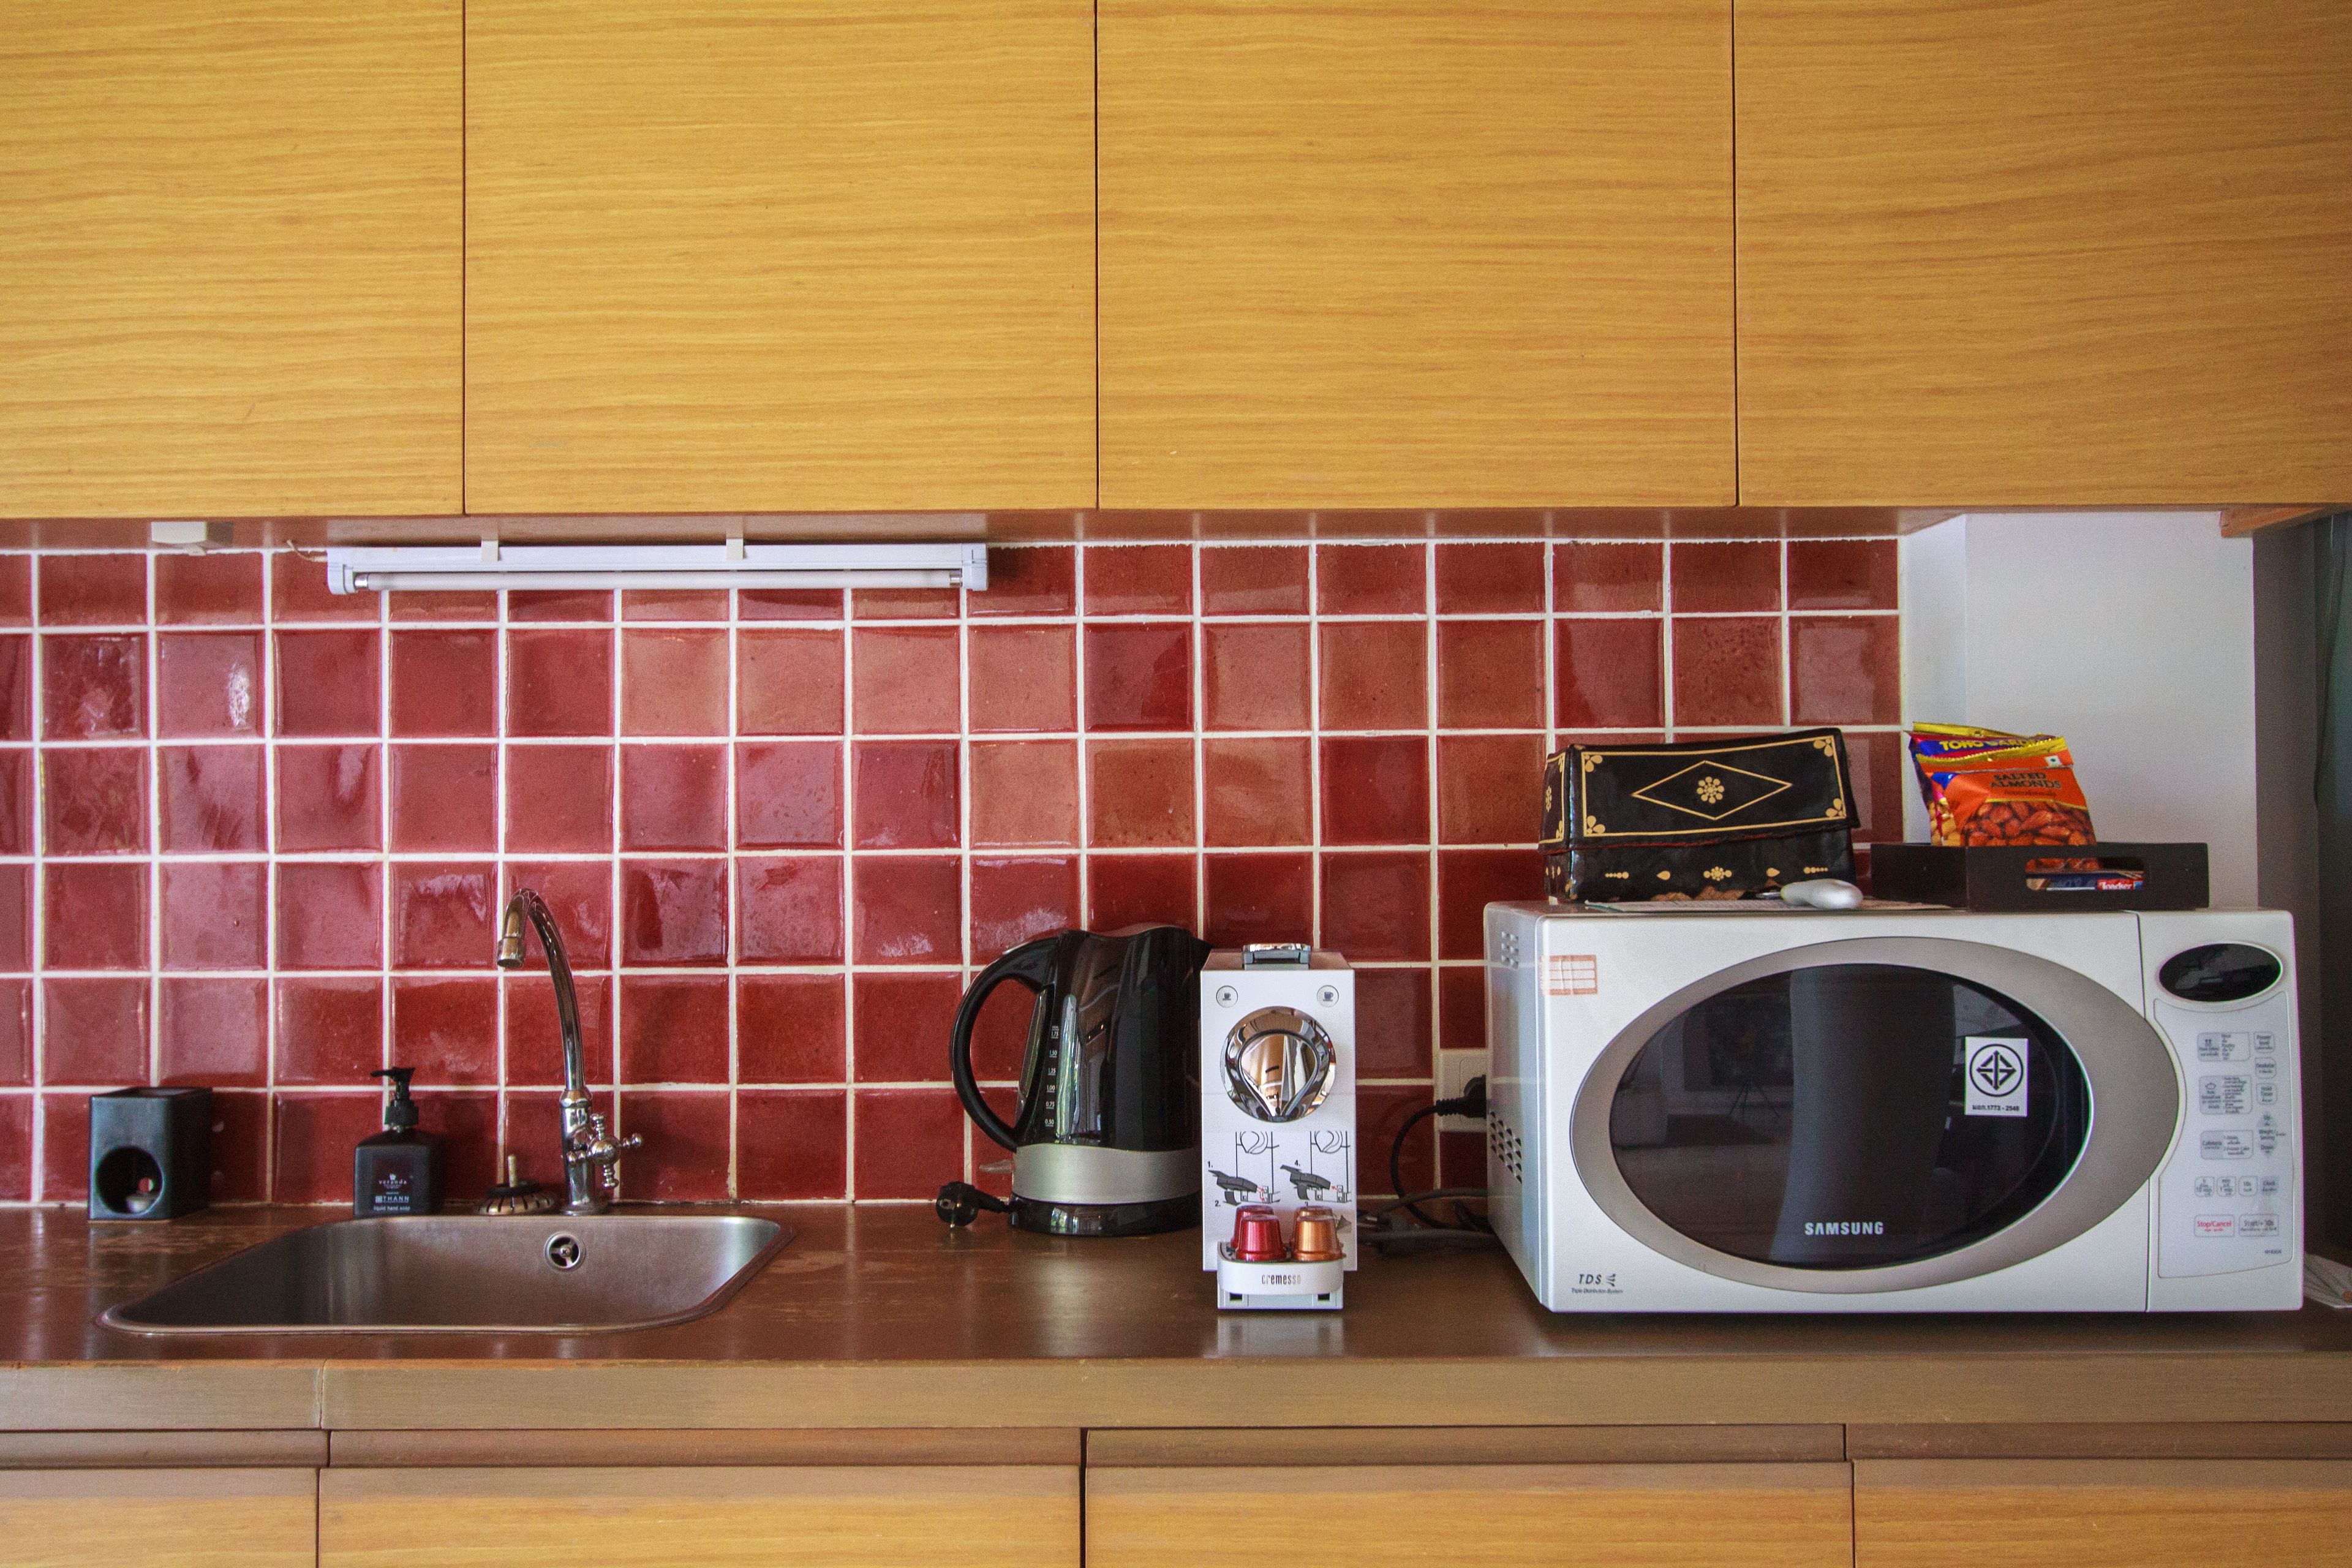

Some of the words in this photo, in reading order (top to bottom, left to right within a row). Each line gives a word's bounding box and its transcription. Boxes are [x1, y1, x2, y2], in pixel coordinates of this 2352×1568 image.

[1994, 772, 2047, 781] SALTED
[1991, 779, 2061, 790] ALMONDS
[1804, 1221, 1884, 1235] SAMSUNG
[1261, 1274, 1302, 1285] cremesso
[1579, 1273, 1602, 1285] TDS
